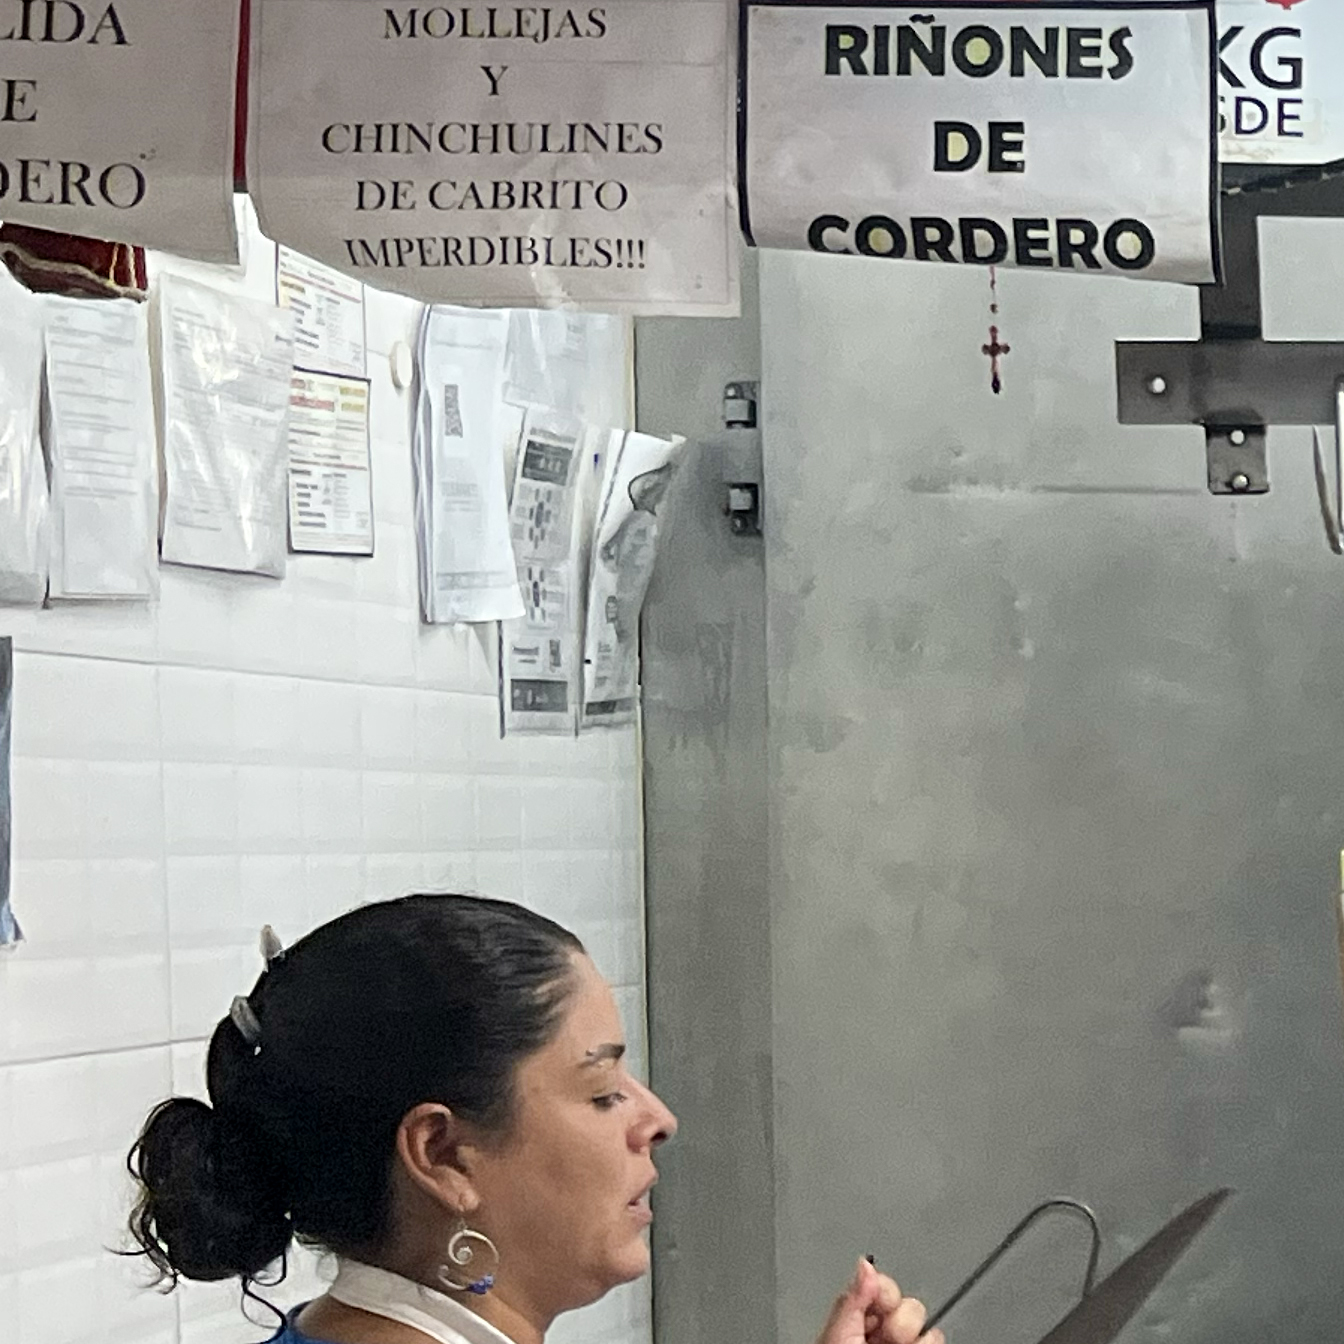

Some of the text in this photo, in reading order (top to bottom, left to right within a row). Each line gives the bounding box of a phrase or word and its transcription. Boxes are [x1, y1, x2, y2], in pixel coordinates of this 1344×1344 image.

[384, 8, 607, 43] MOLLEJAS
[824, 13, 1134, 79] RIÑONES
[480, 64, 509, 97] Y
[321, 122, 663, 154] CHINCHULINES
[932, 121, 1025, 173] DE
[355, 179, 628, 211] DE CABRITO
[343, 236, 646, 269] IMPERDIBLES!!!
[807, 214, 1156, 271] CORDERO
